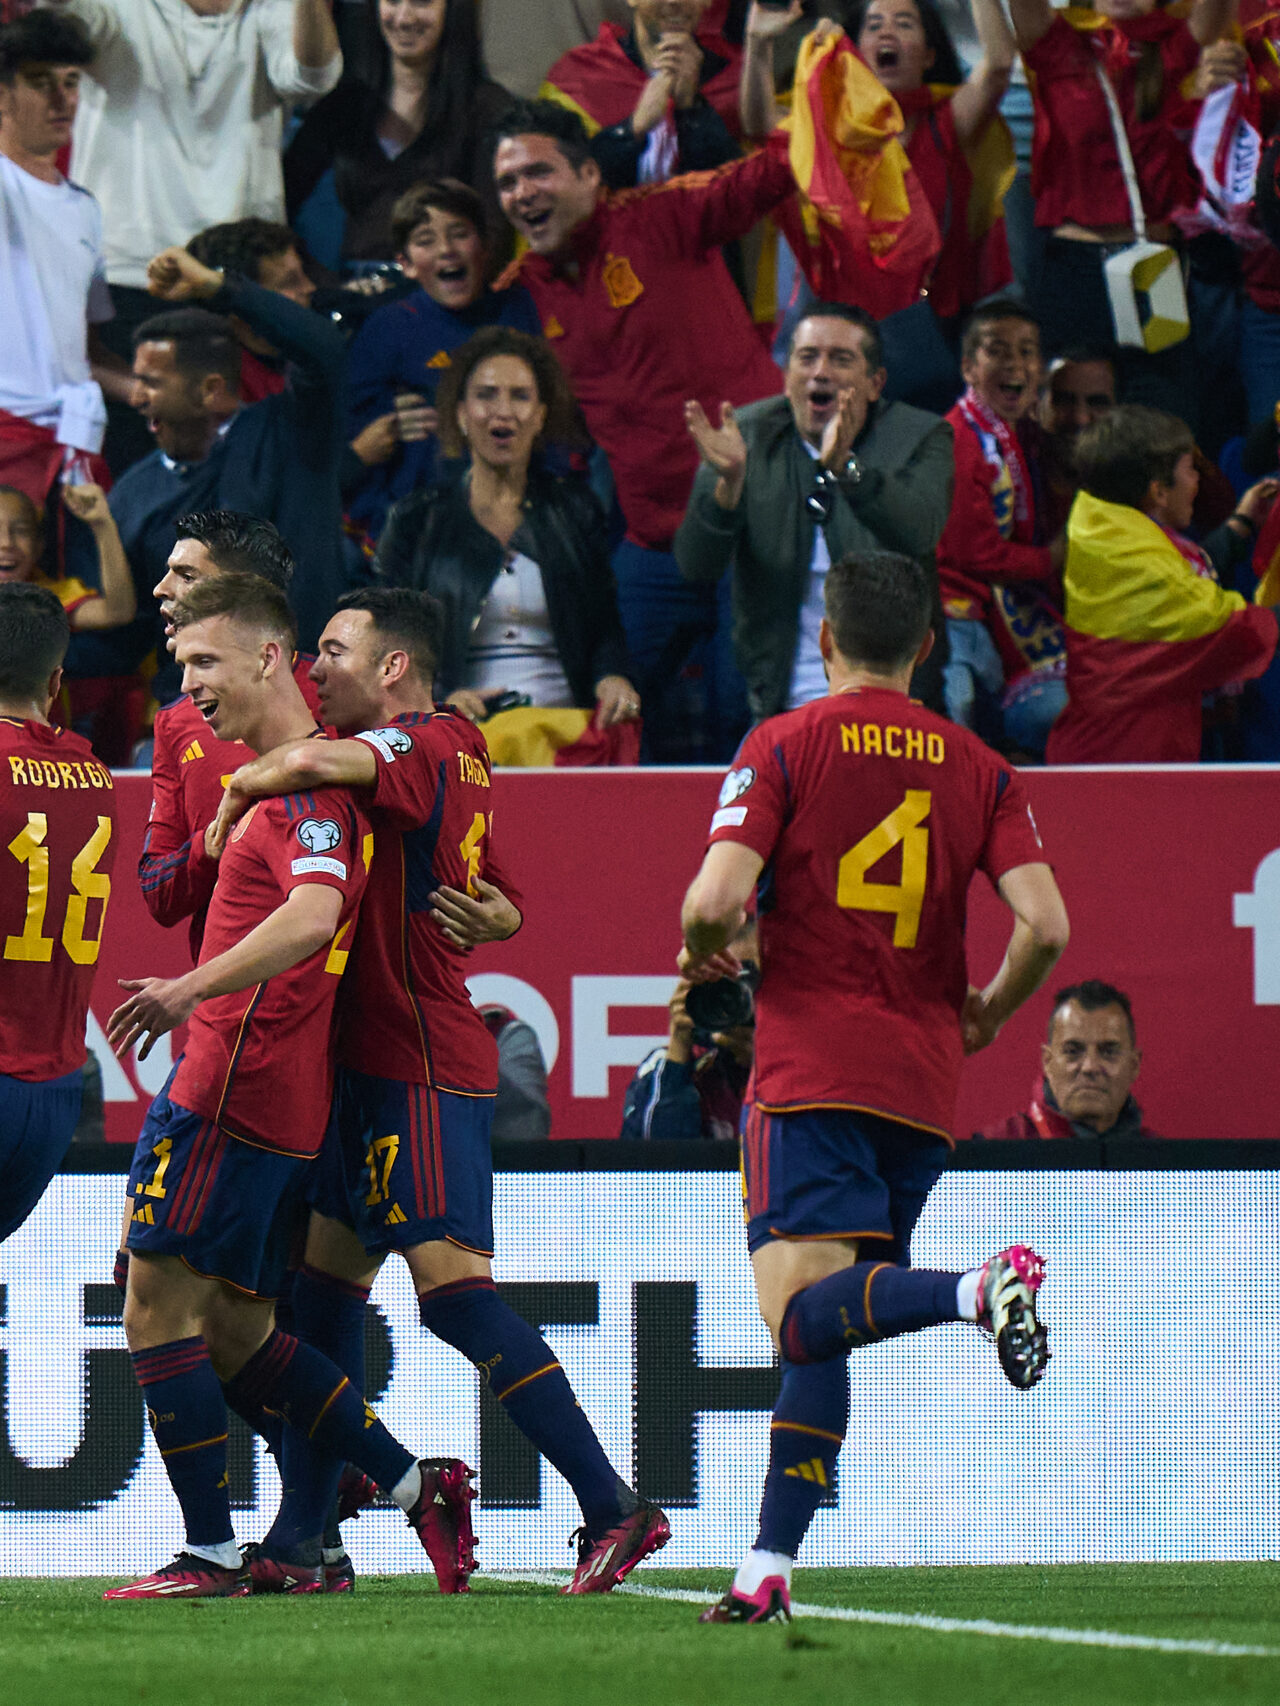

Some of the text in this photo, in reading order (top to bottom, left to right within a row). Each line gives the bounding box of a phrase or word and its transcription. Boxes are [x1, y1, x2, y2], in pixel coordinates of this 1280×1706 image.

[8, 756, 114, 789] RODRIGO
[840, 723, 945, 764] NACHO
[3, 811, 112, 965] 16
[837, 788, 932, 949] 4
[365, 1133, 401, 1207] 17
